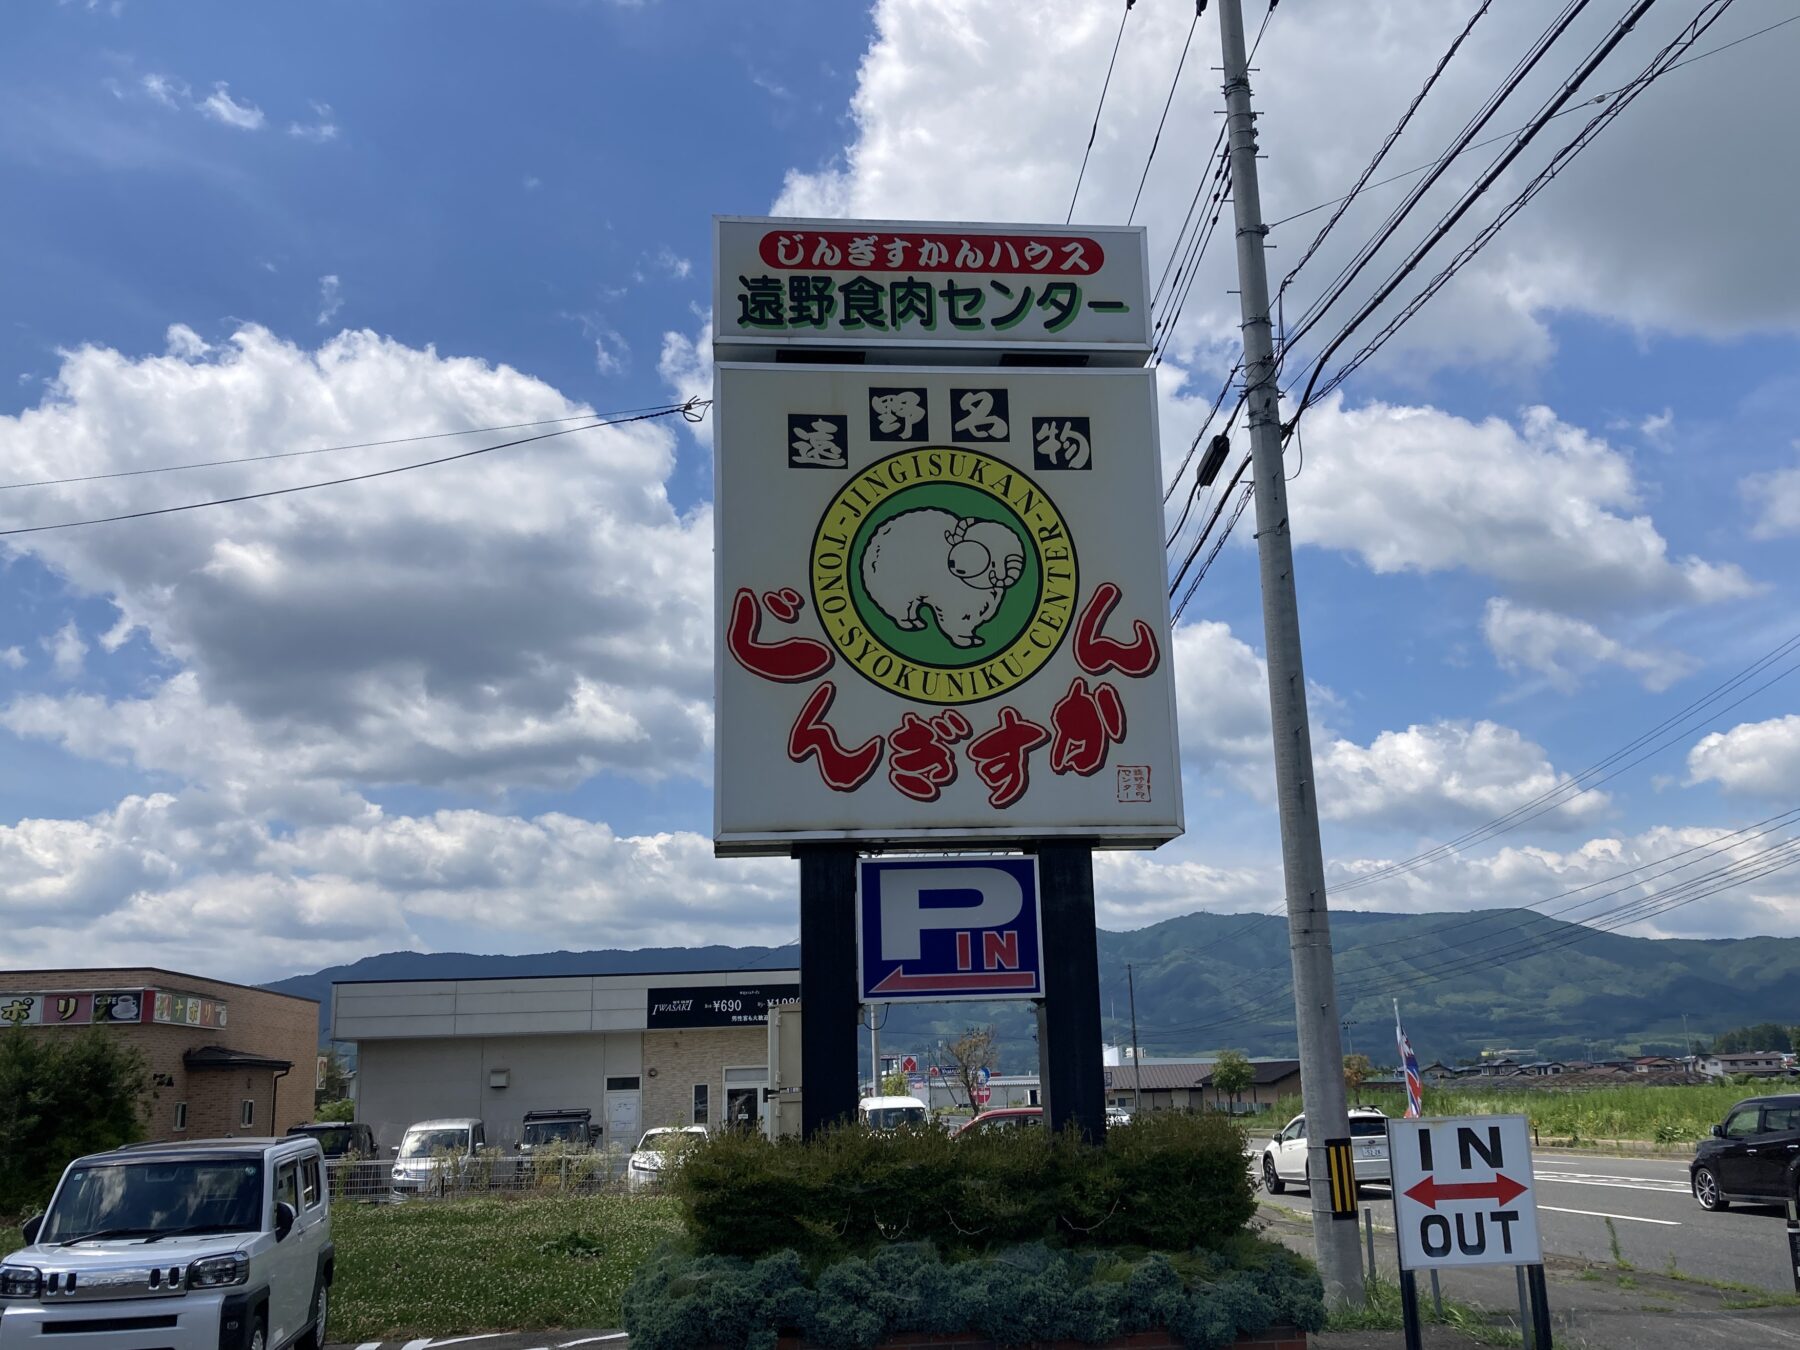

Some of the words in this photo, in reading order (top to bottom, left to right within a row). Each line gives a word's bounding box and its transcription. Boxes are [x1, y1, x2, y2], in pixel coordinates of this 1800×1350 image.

[777, 235, 1091, 272] じんぎすかんハウス
[737, 275, 1129, 333] 遠野食肉センター
[879, 867, 1024, 962] P
[955, 930, 1020, 971] IN
[651, 999, 694, 1016] IWASAKI
[1418, 1126, 1504, 1171] IN
[1420, 1210, 1520, 1258] OUT
